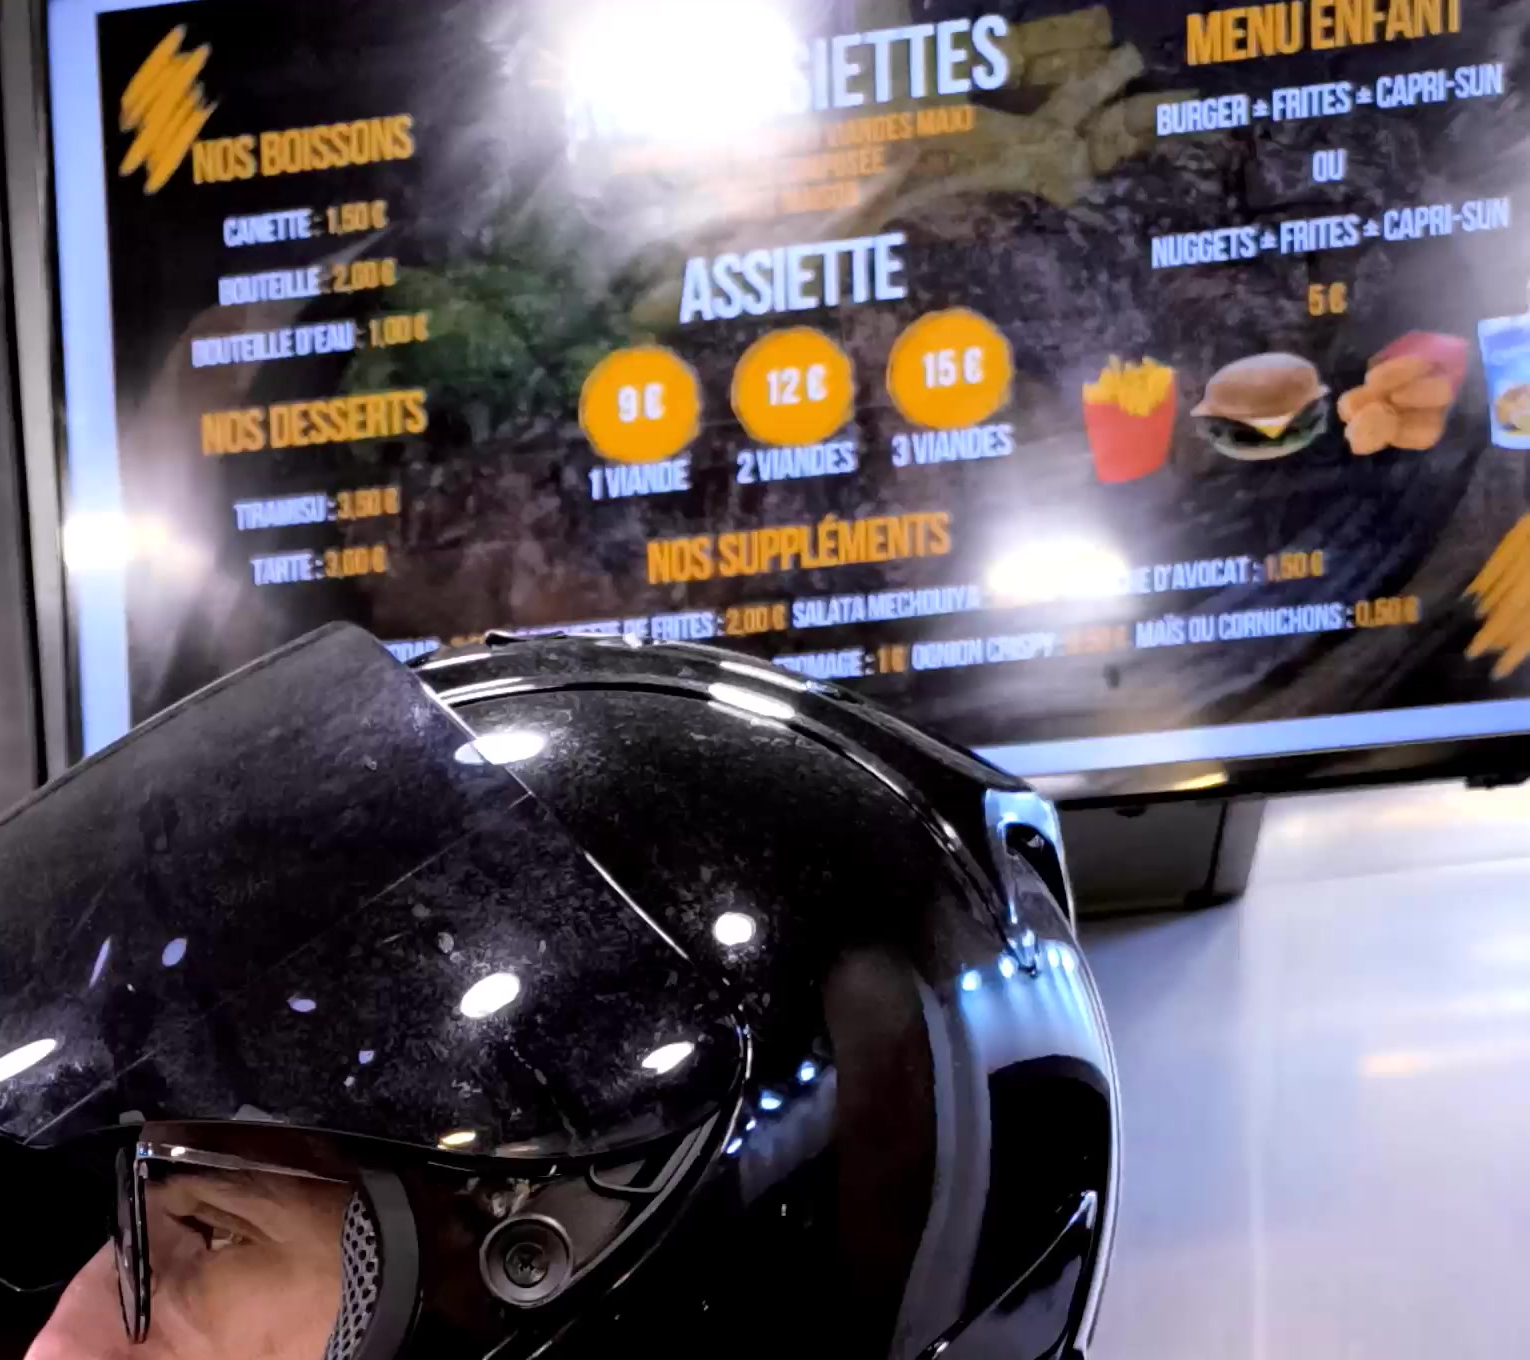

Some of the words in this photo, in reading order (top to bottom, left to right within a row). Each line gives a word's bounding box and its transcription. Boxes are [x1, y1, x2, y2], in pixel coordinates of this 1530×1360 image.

[1185, 1, 1303, 66] MENU
[1310, 0, 1462, 50] ENFANT
[805, 14, 1010, 112] IETTES
[1156, 93, 1250, 136] BURGER
[1272, 81, 1352, 122] FRITES
[1375, 62, 1504, 109] CAPRI-SUN
[192, 134, 256, 184] NOS
[260, 113, 414, 176] BOISSONS
[1311, 148, 1347, 183] OU
[223, 207, 312, 247] CANETTE
[1151, 226, 1257, 269] NUGGETS
[1279, 214, 1360, 254] FRITES
[1383, 197, 1511, 241] CAPRI-SUN
[679, 231, 907, 324] ASSIETTE
[766, 369, 800, 405] 12
[921, 350, 955, 388] 15
[201, 408, 266, 456] NOS
[268, 389, 427, 449] DESSERTS
[617, 386, 638, 422] 9
[736, 451, 756, 484] 2
[757, 441, 858, 482] VIANDES
[891, 434, 910, 467] 3
[910, 424, 1015, 465] VIANDES
[606, 457, 691, 499] VIANDE
[646, 536, 713, 584] NOS
[718, 511, 951, 578] SUPPLÉMENTS
[1153, 555, 1249, 592] D'AVOCAT
[792, 596, 866, 628] SALATA
[1135, 613, 1186, 649] MAÏS
[1188, 613, 1217, 643] OU
[1219, 601, 1342, 640] CORNICHONS
